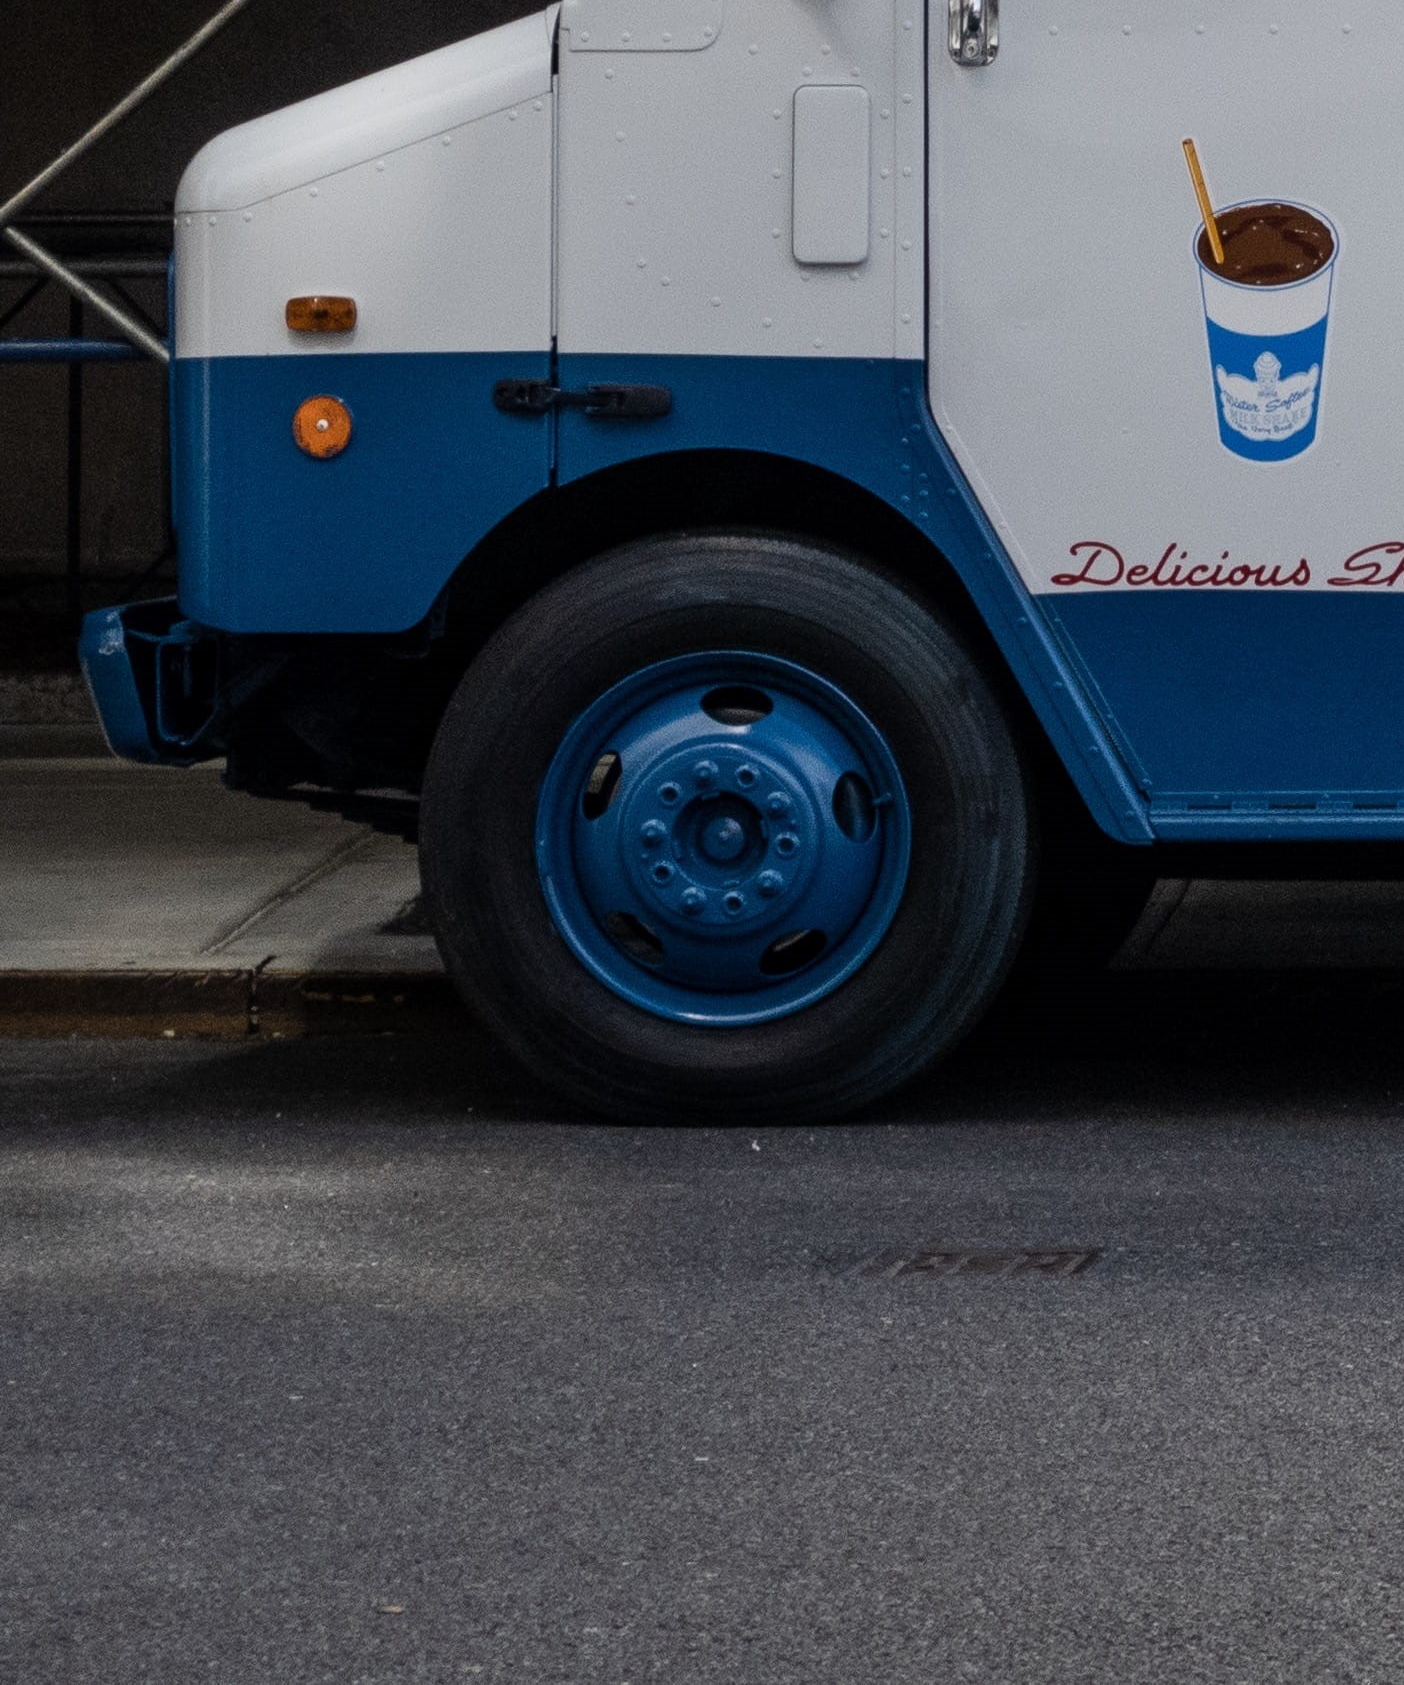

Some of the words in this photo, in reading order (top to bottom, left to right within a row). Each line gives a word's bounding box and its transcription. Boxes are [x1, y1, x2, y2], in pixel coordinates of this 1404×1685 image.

[1223, 390, 1260, 413] Mister
[1265, 387, 1311, 413] Softee
[1050, 541, 1312, 588] Delicious
